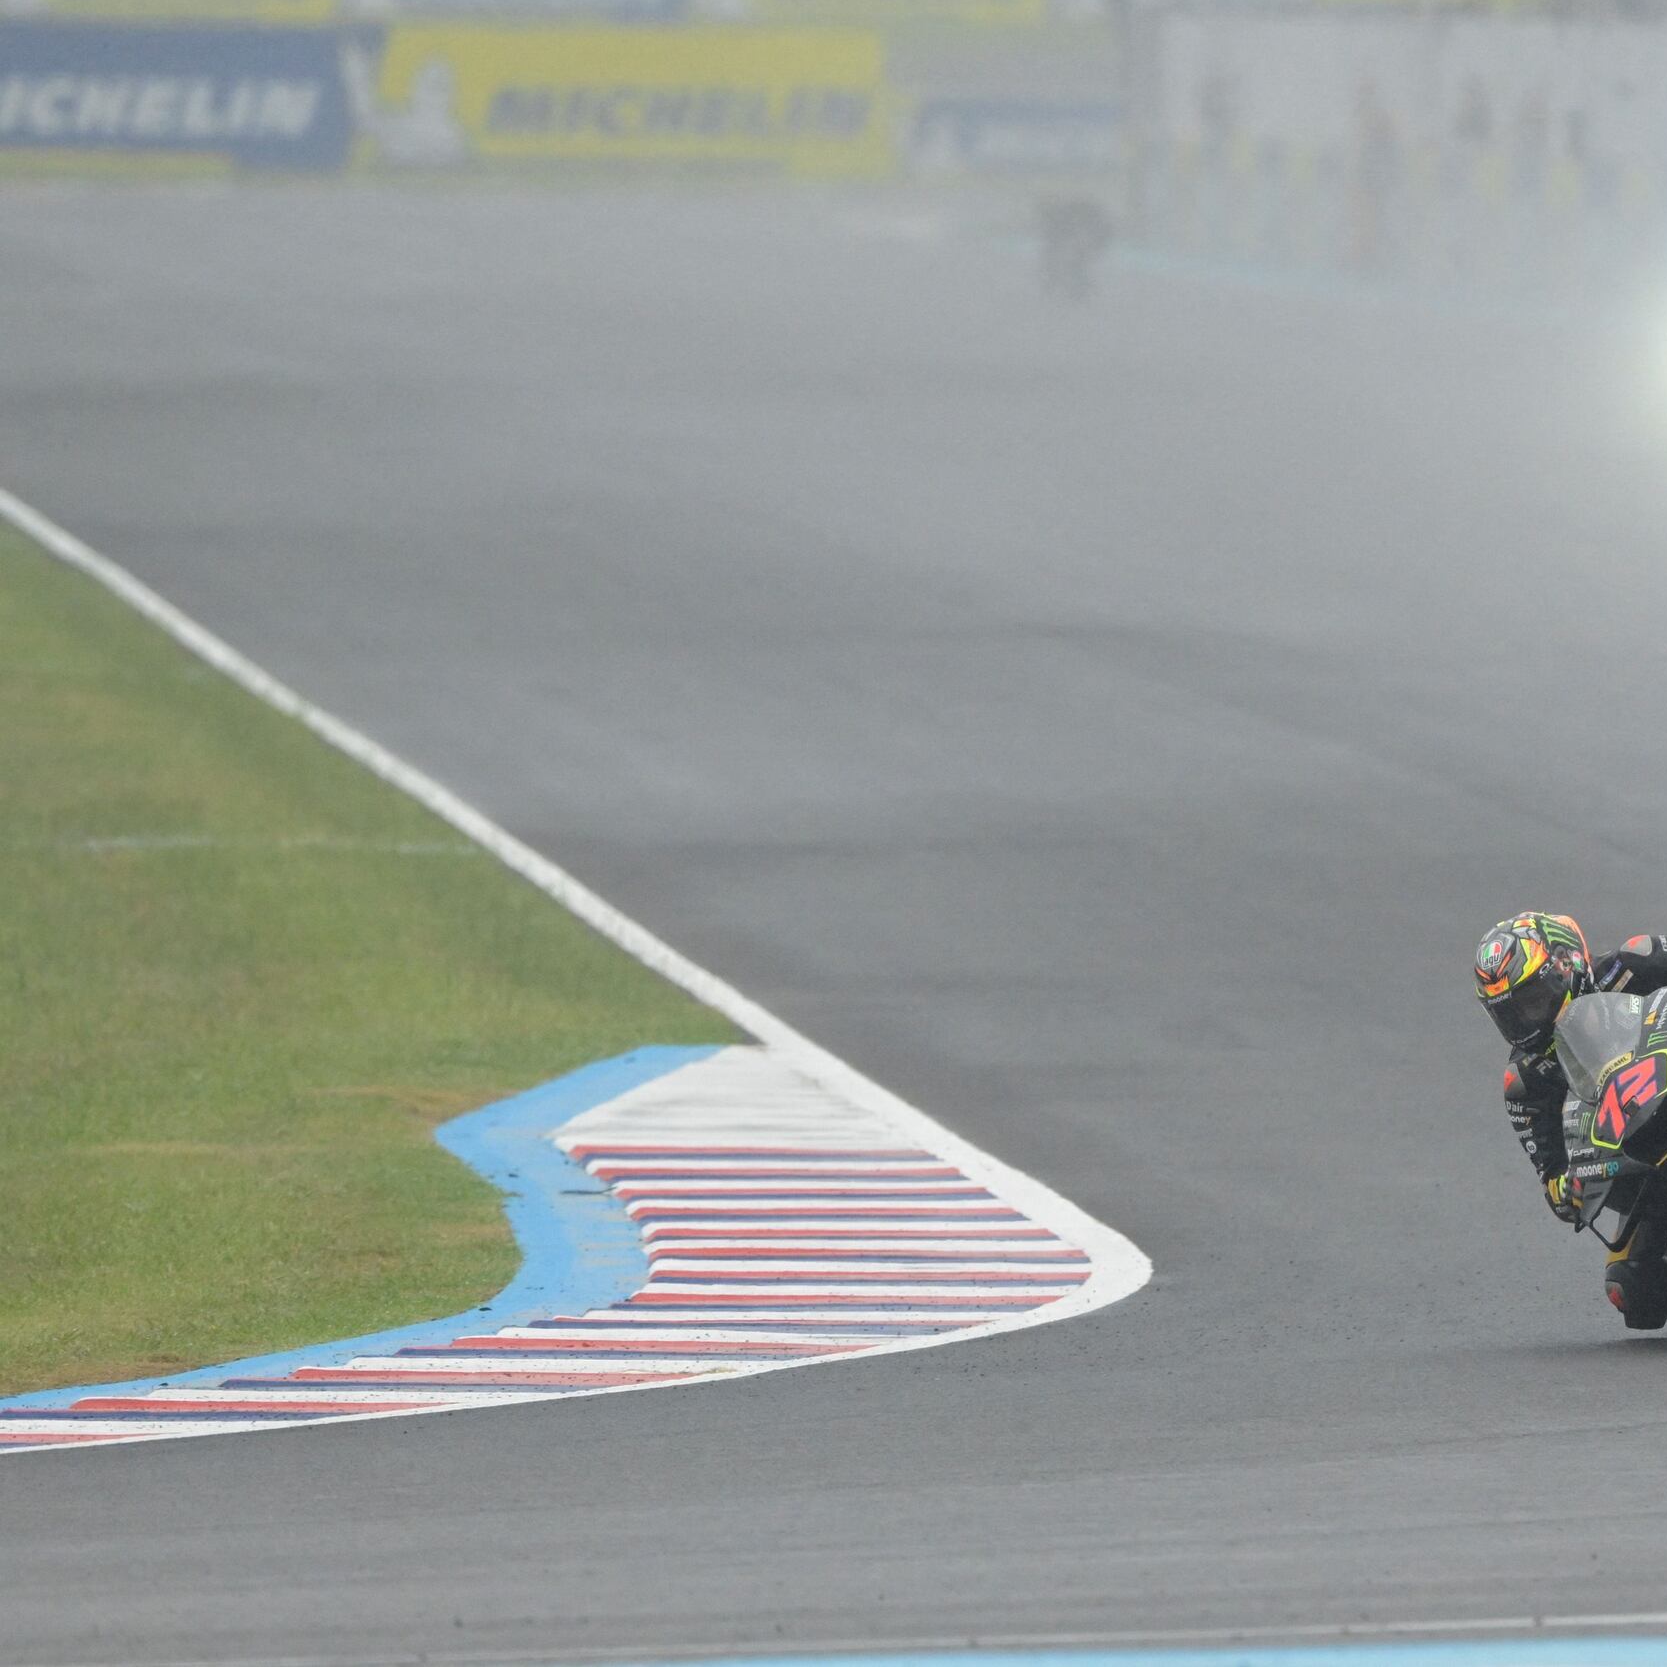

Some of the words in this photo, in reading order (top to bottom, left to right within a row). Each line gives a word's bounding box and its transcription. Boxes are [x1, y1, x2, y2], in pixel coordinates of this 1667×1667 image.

[0, 76, 320, 140] ICHELIN
[486, 85, 872, 141] MICHELIN
[1597, 1056, 1658, 1141] 72
[1576, 1160, 1620, 1179] mooneygo
